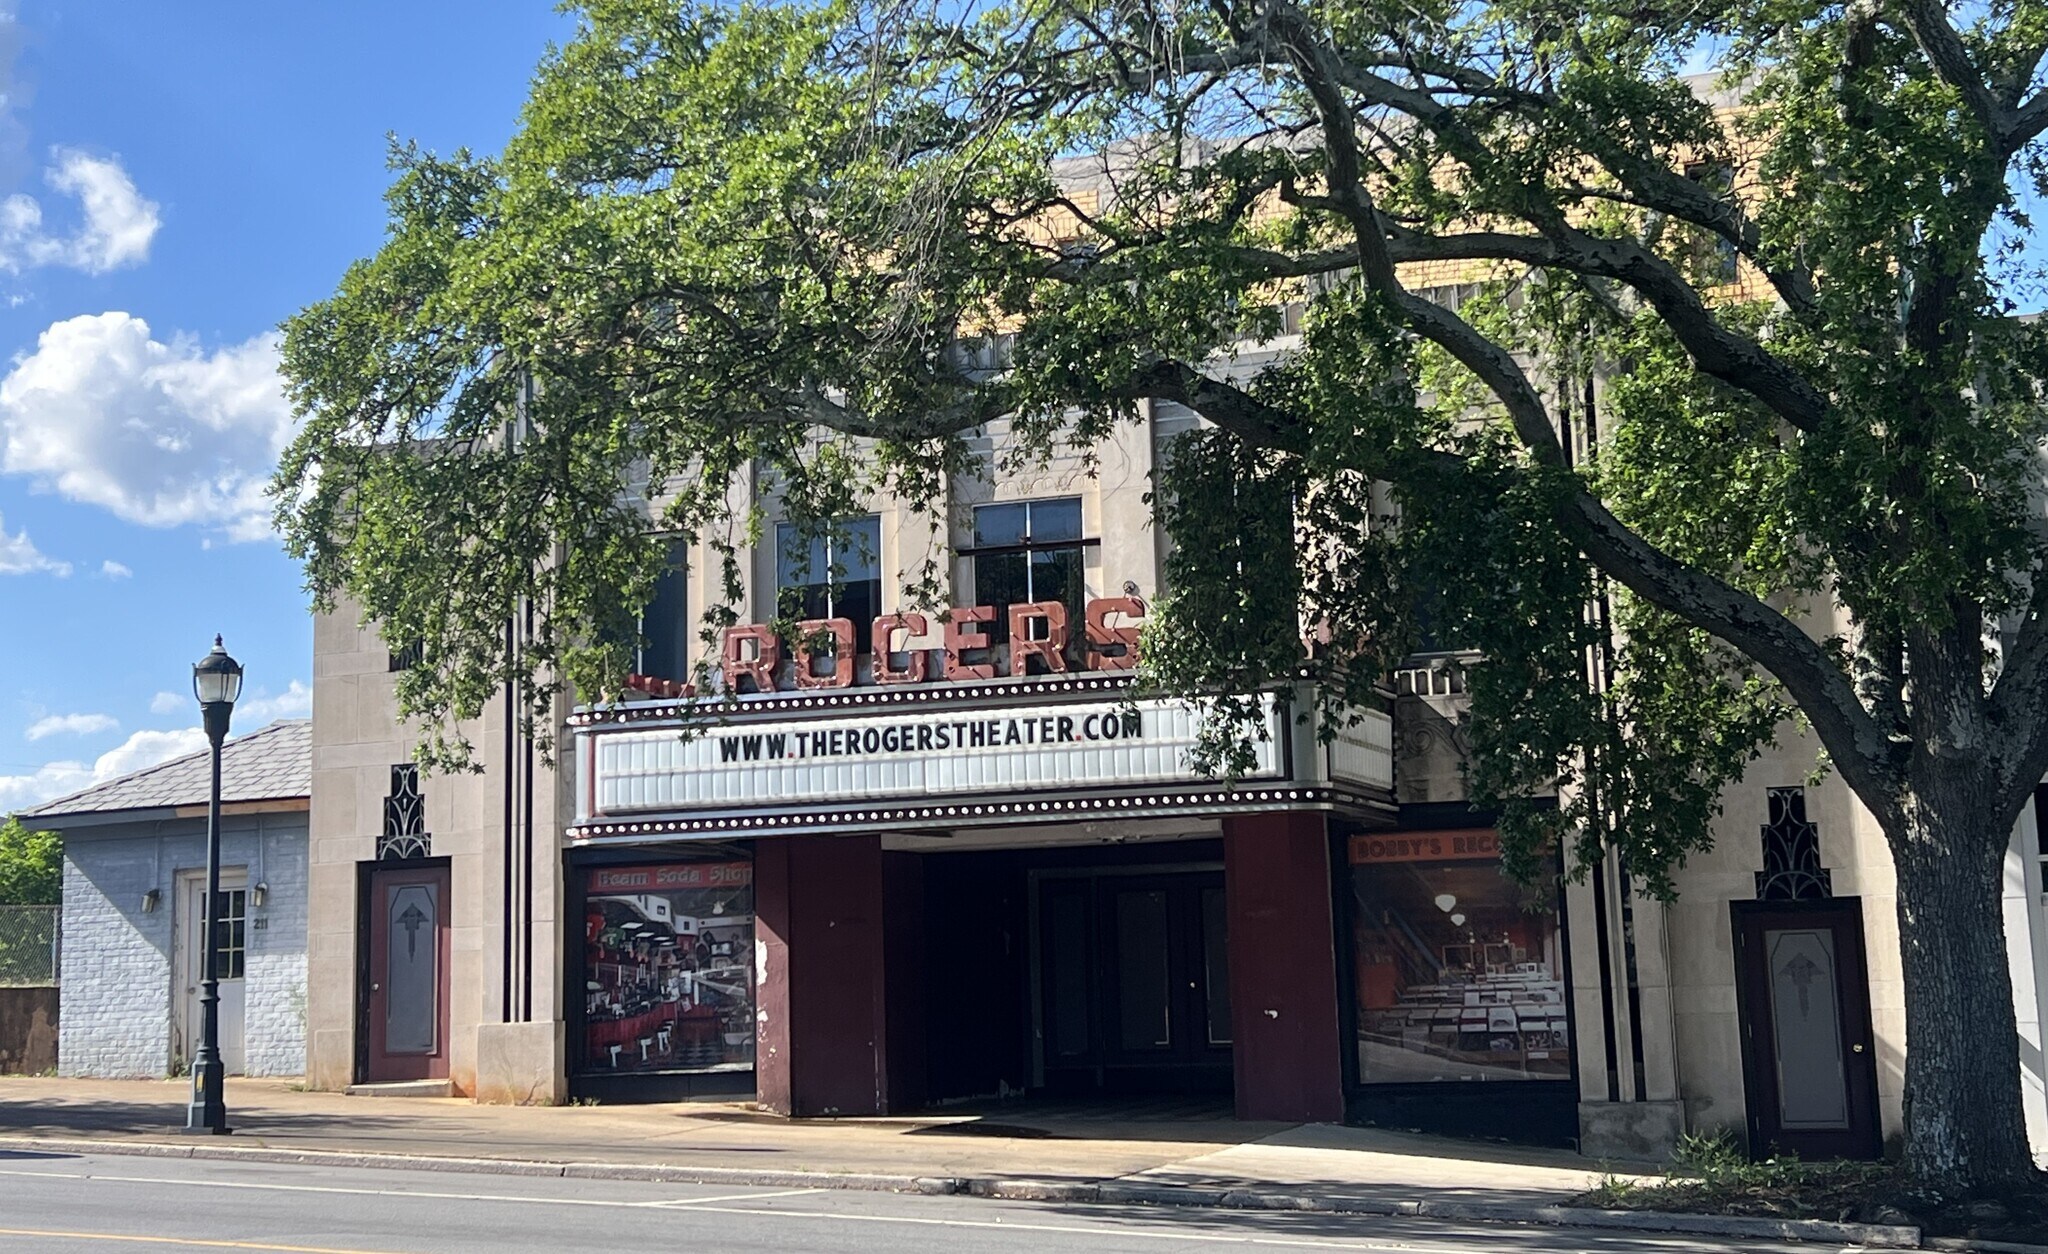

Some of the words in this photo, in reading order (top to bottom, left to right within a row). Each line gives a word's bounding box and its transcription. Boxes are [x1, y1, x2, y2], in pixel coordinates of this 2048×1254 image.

[724, 598, 1145, 692] ROGERS
[720, 712, 1143, 762] WWW.THEROGERSTHEATER.COM
[1358, 838, 1441, 858] BOBBY'S
[656, 866, 701, 883] Soda
[254, 918, 268, 929] 211
